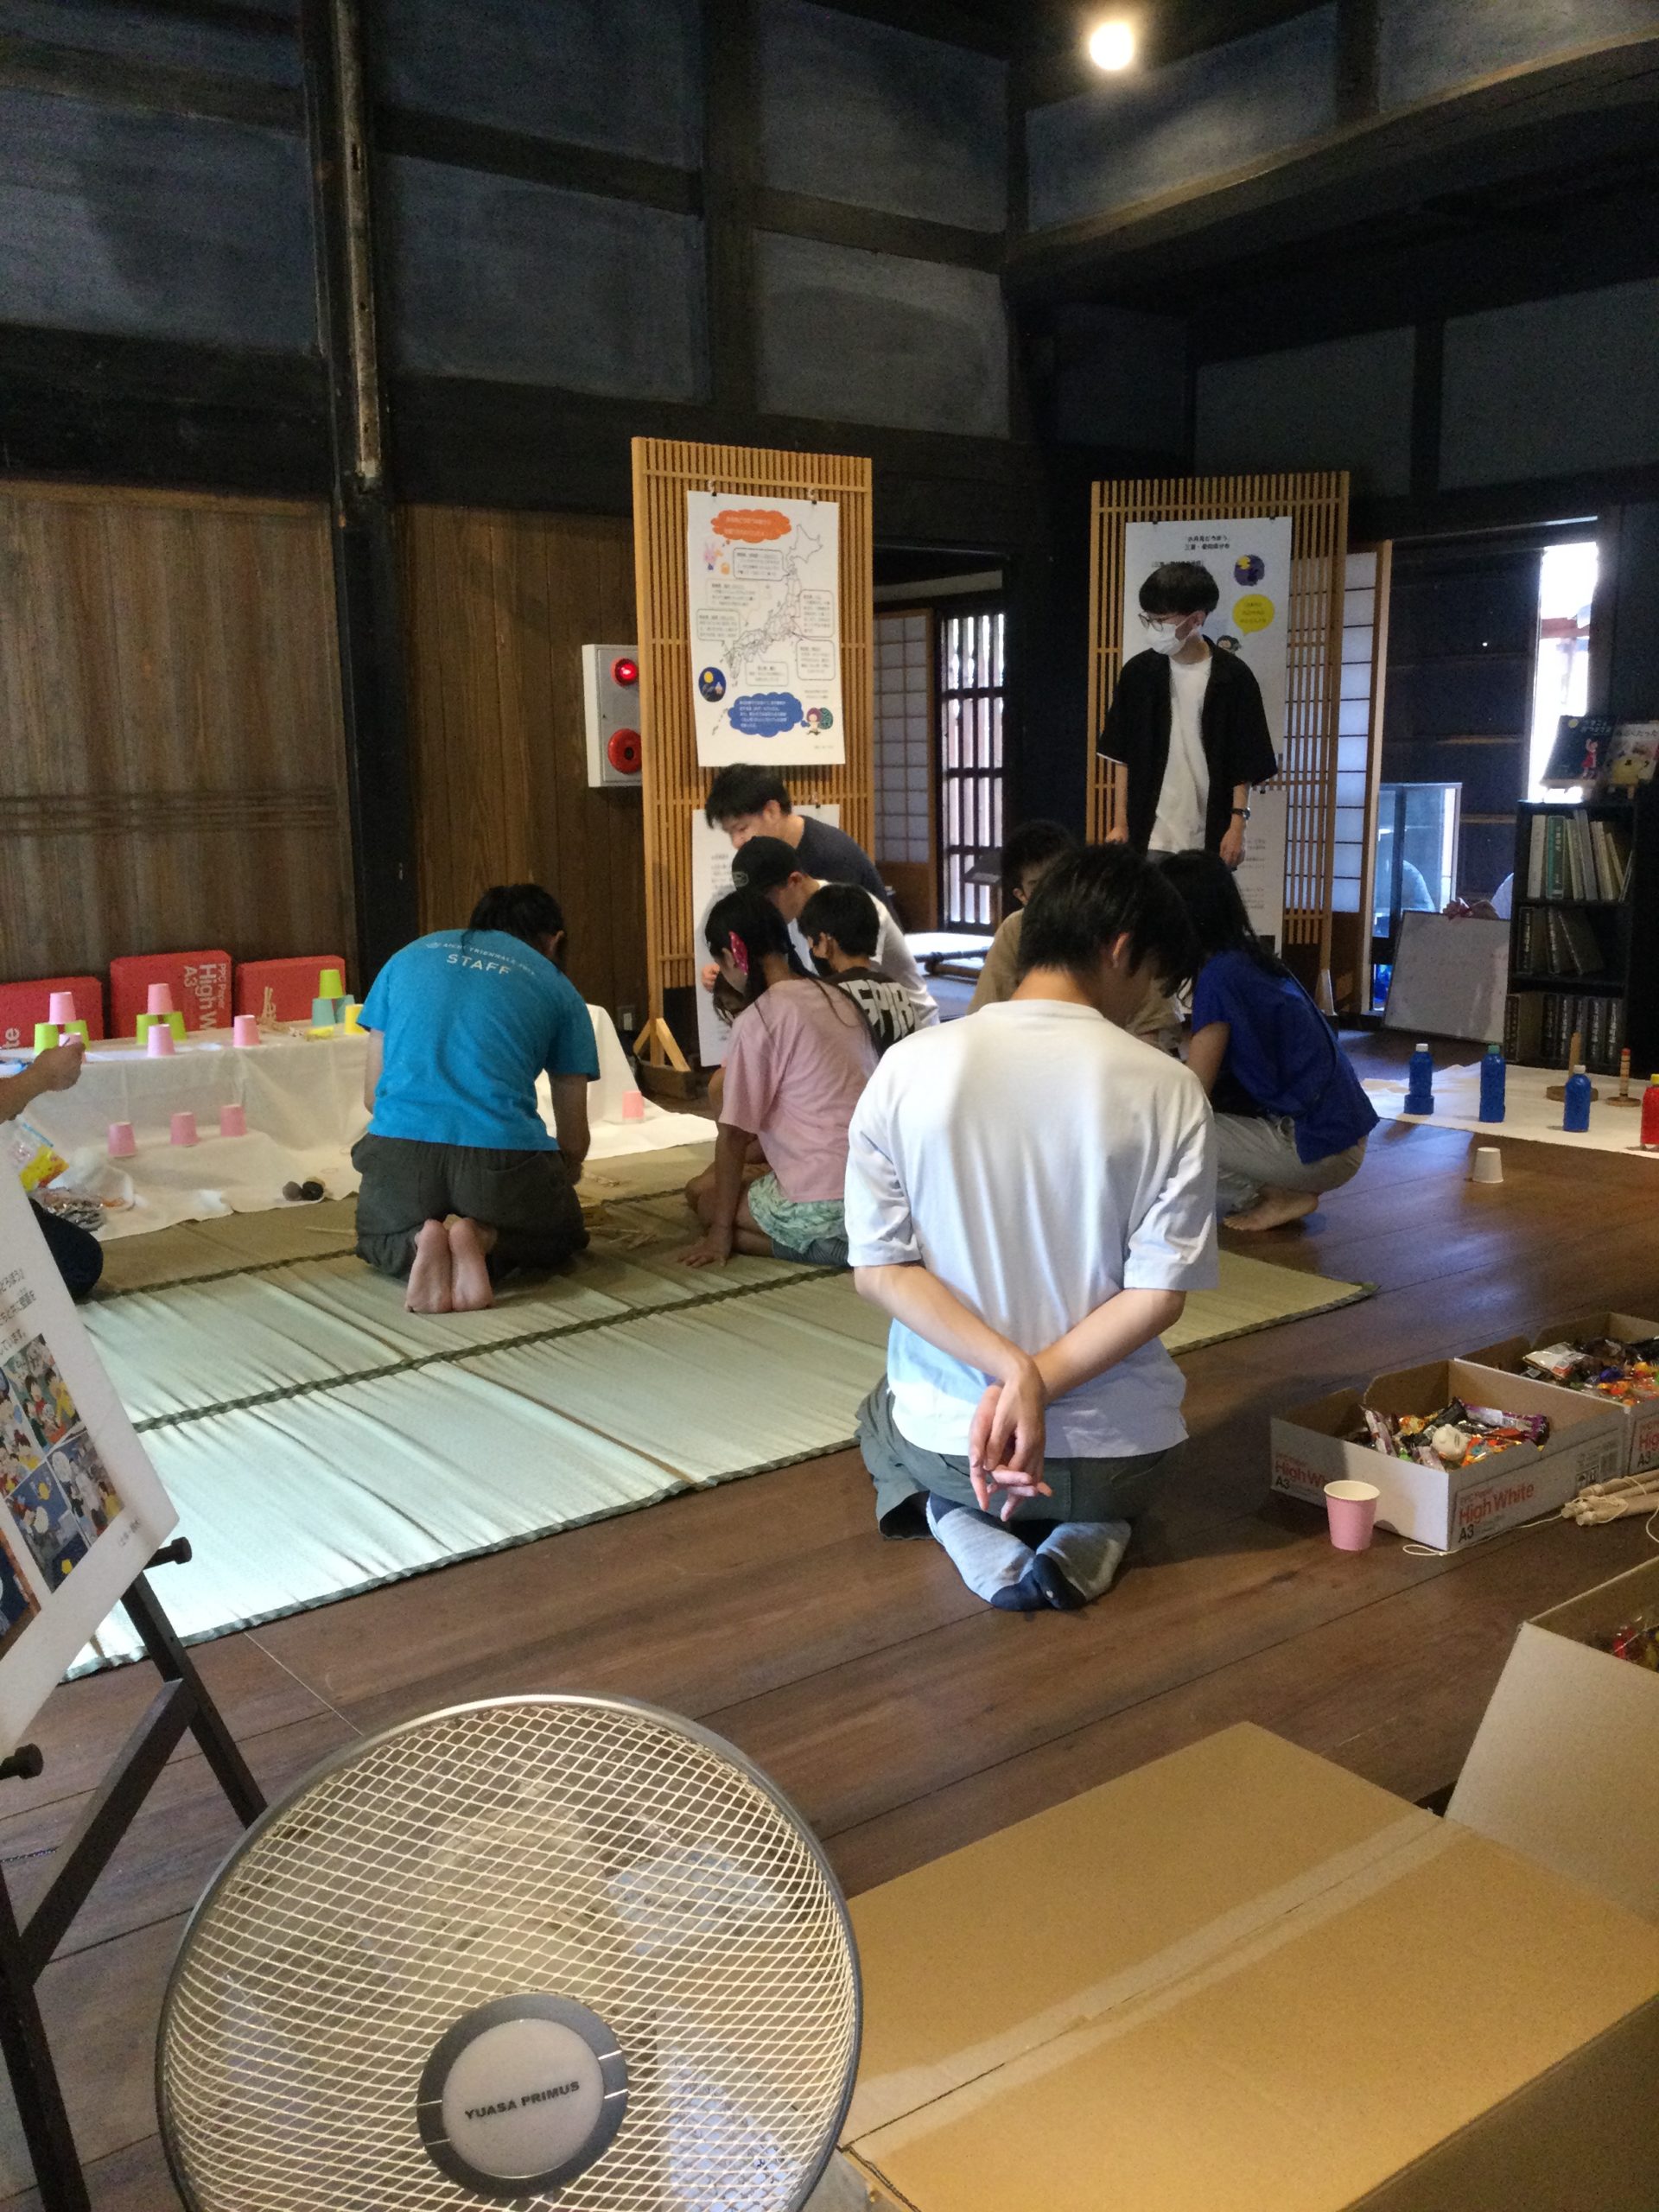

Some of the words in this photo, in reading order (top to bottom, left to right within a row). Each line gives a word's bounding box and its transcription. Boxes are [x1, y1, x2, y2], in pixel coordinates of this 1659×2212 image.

[446, 953, 512, 975] STAFF
[183, 965, 198, 988] A3
[194, 963, 217, 1010] High
[1637, 1450, 1651, 1468] A3
[1274, 1459, 1306, 1484] High
[1275, 1475, 1290, 1490] A3
[1459, 1498, 1491, 1527] High
[1493, 1482, 1535, 1512] White
[1458, 1523, 1474, 1543] A3
[465, 2101, 517, 2120] YUASA
[521, 2081, 580, 2107] PRIMUS
